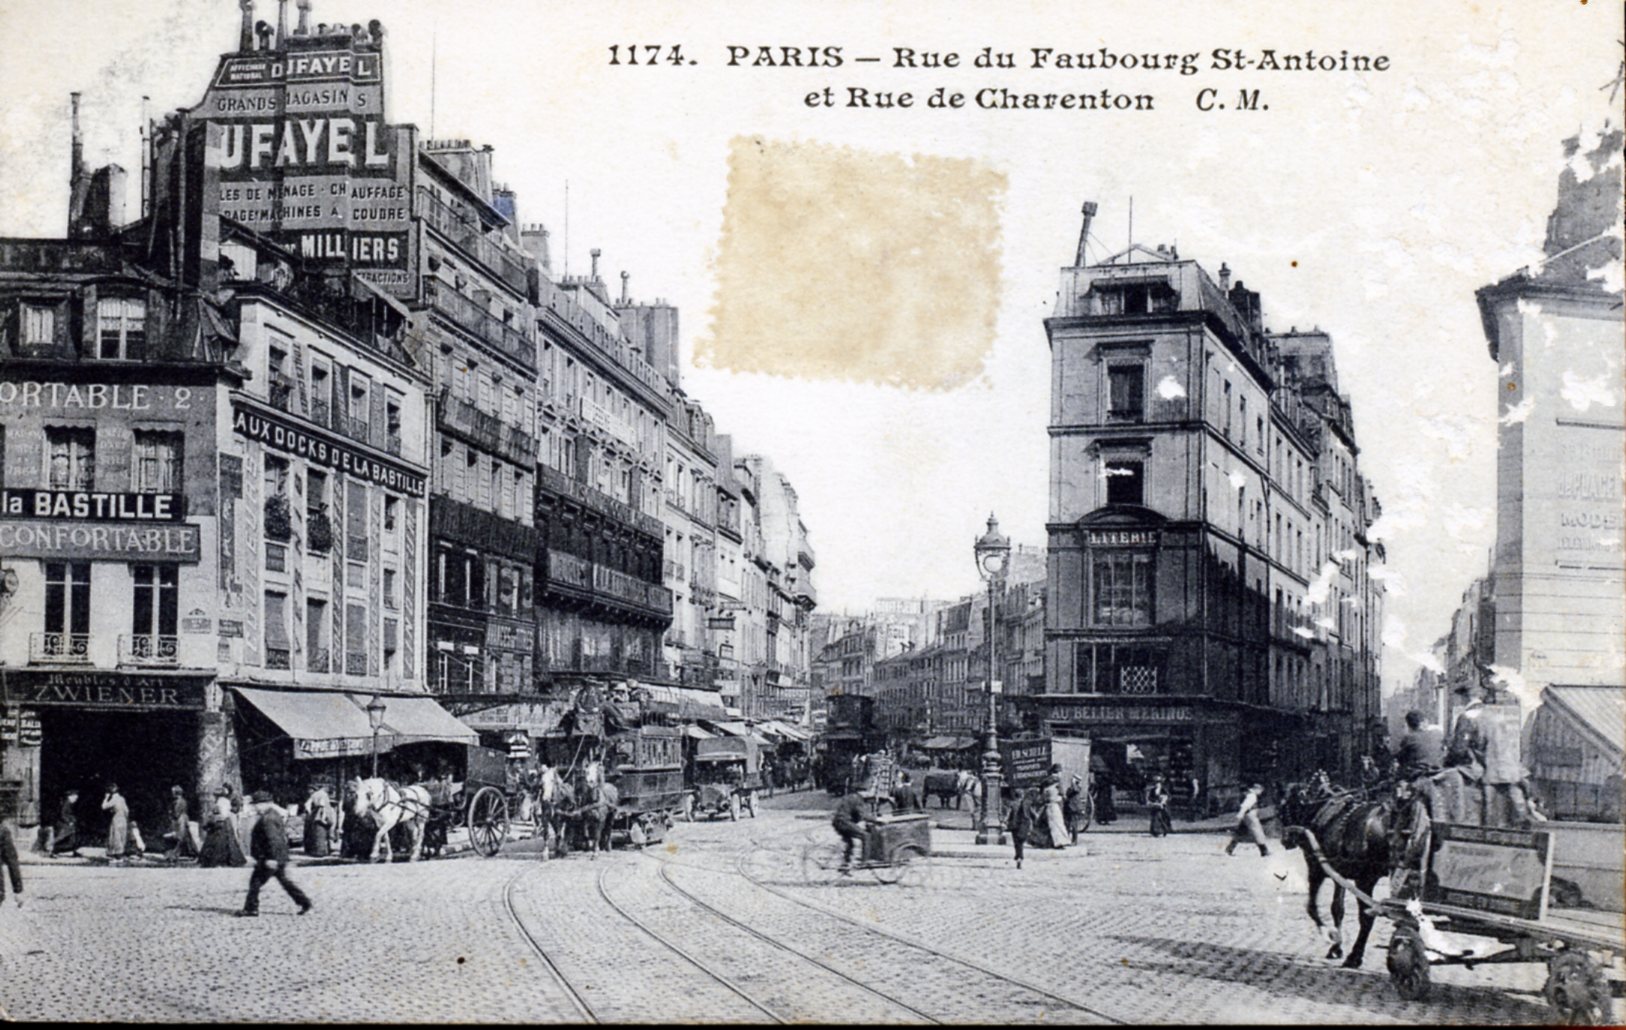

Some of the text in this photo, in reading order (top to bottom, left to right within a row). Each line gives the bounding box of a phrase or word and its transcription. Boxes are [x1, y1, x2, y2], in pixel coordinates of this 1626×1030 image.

[217, 96, 277, 112] GRANDS
[246, 188, 261, 200] DE
[330, 183, 404, 199] CHAUFFAGE
[260, 205, 321, 220] MACHINES
[352, 207, 405, 220] COUDRE
[301, 234, 399, 260] MILLIERS
[0, 381, 191, 410] ORTABLE 2
[235, 412, 425, 496] AUX DOCKS DE LA BASTILLE
[1, 491, 173, 519] la BASTILLE
[0, 525, 195, 554] CONFORTABLE
[33, 685, 179, 704] ZWIENER
[1051, 706, 1069, 720] AU
